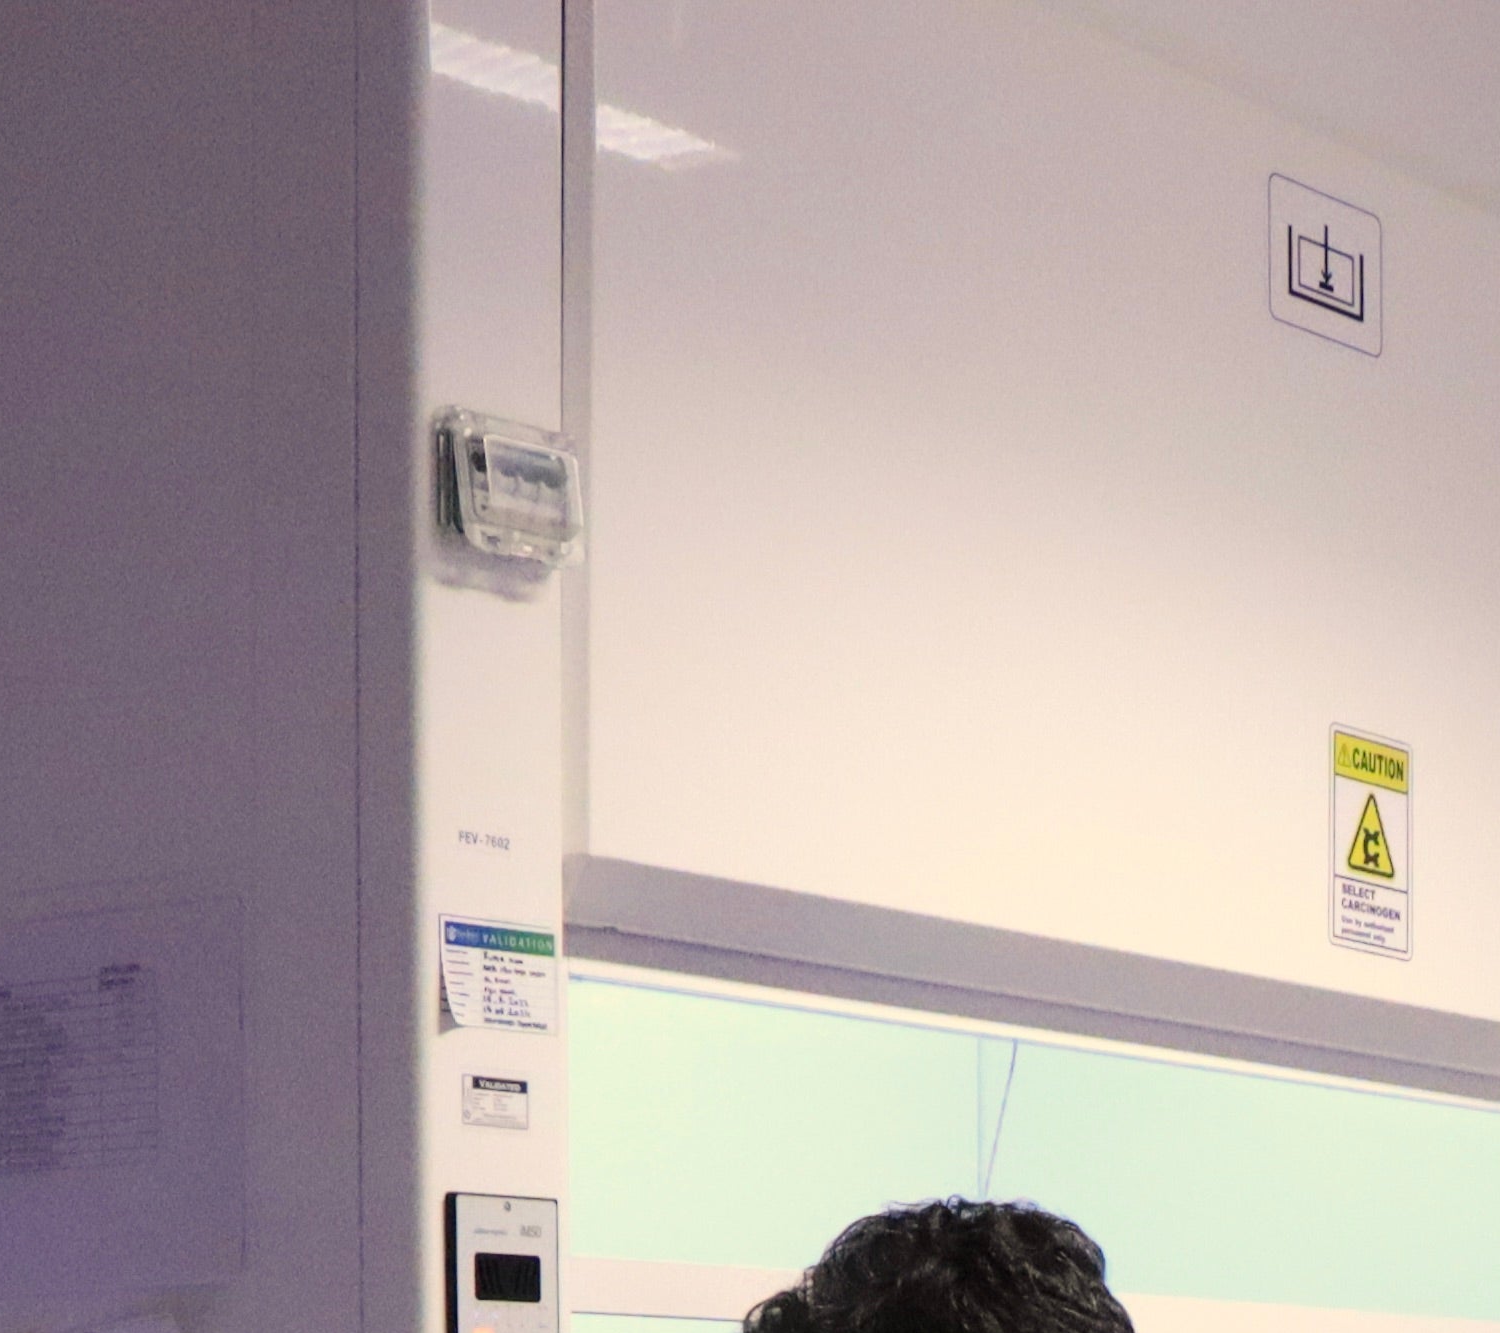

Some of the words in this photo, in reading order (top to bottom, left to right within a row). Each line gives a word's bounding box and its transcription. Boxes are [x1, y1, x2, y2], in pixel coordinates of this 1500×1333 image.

[1352, 747, 1404, 782] CAUTION
[1342, 883, 1376, 900] SELECT
[1341, 898, 1401, 921] CARCINOGEN
[482, 933, 553, 951] VALIDATION
